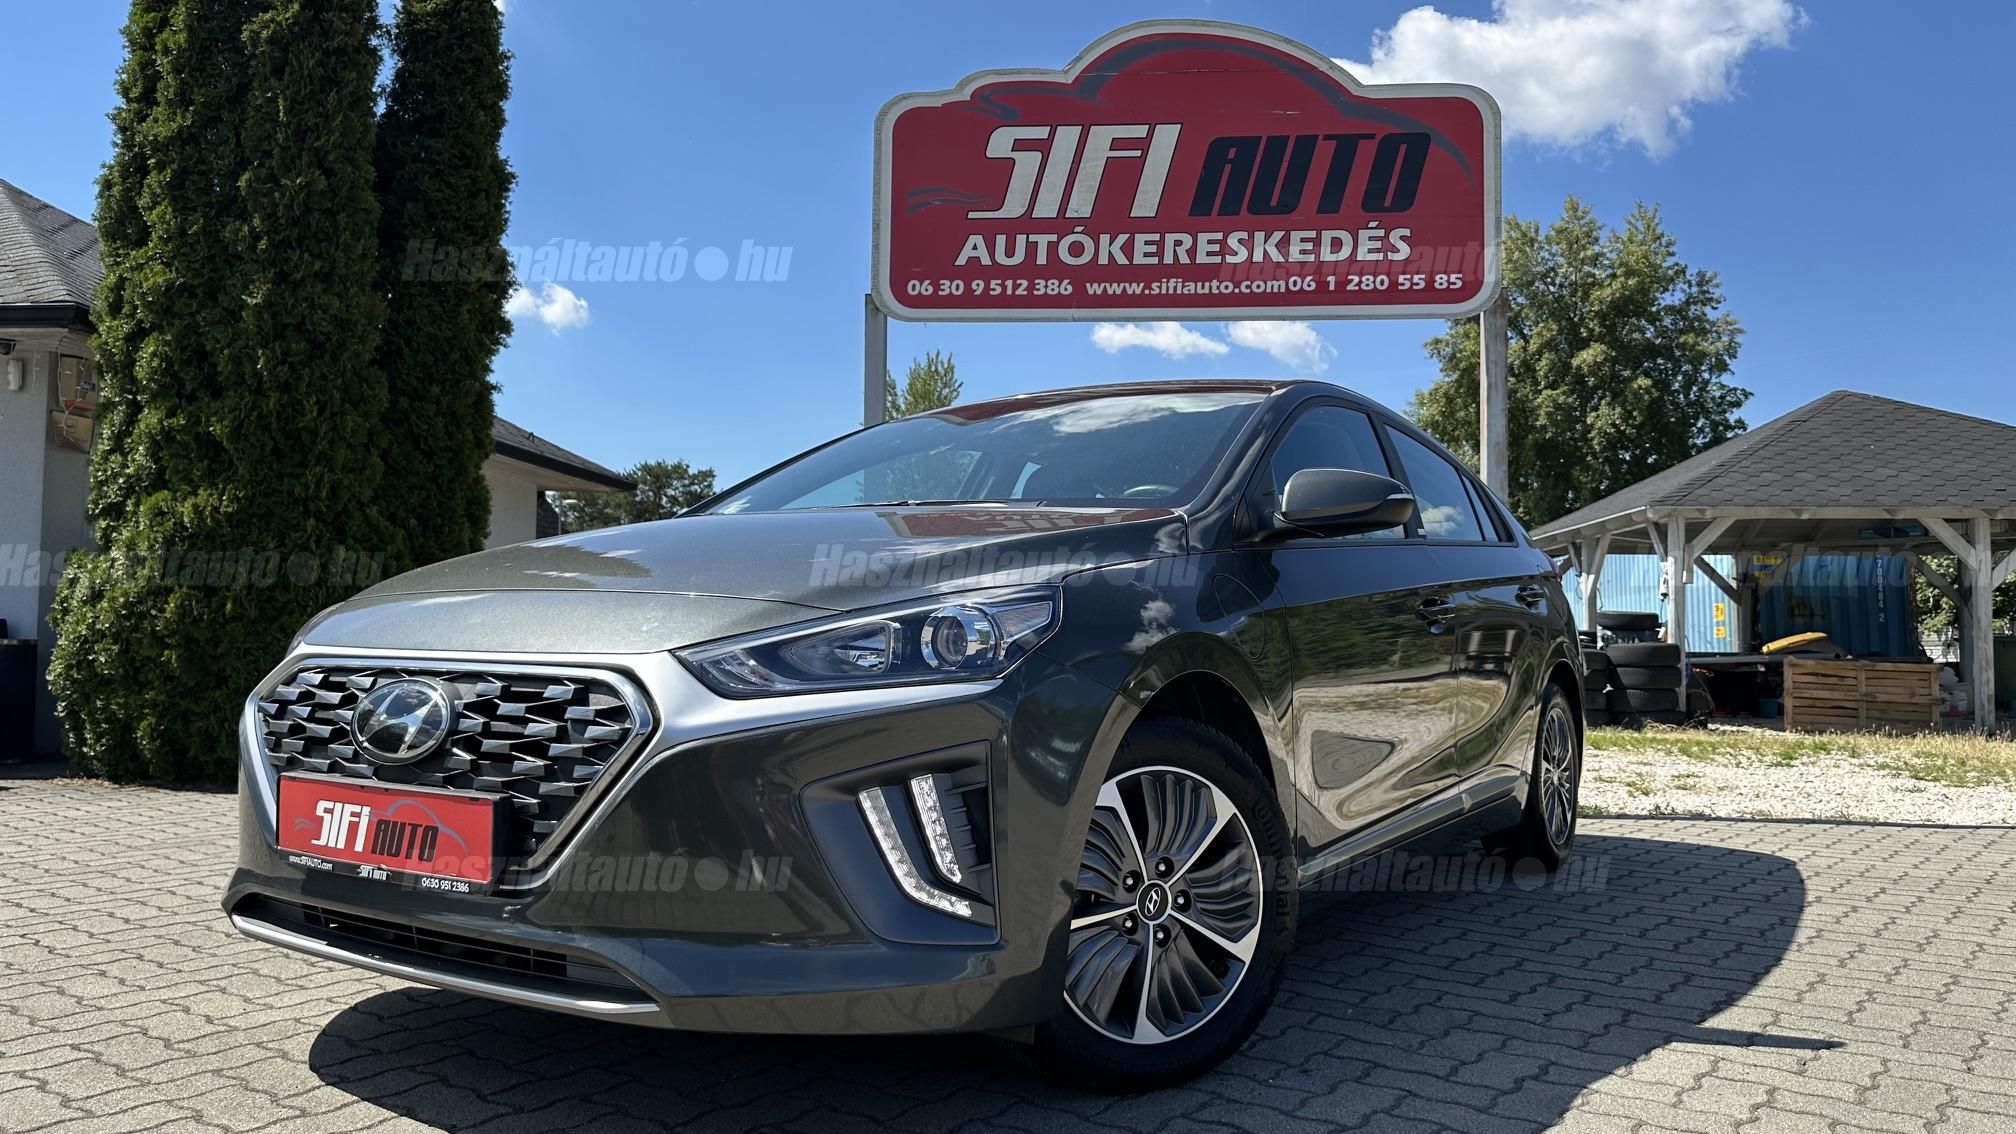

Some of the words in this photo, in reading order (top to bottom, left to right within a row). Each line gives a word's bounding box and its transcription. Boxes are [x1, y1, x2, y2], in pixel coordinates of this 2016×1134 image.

[966, 123, 1183, 220] SIFI
[1188, 132, 1431, 217] AUTO
[953, 221, 1412, 267] AUTÓKERESKEDÉS
[907, 280, 934, 296] 06
[938, 280, 965, 296] 30
[1033, 279, 1073, 296] 386
[1086, 276, 1286, 297] www.sifiauto.com
[1288, 276, 1316, 291] 06
[1326, 276, 1336, 291] 1
[1346, 275, 1389, 291] 280
[1398, 275, 1426, 290] 55
[1434, 274, 1463, 290] 85
[370, 818, 439, 862] AUTO
[421, 877, 439, 889] 0630
[452, 881, 469, 893] 2386
